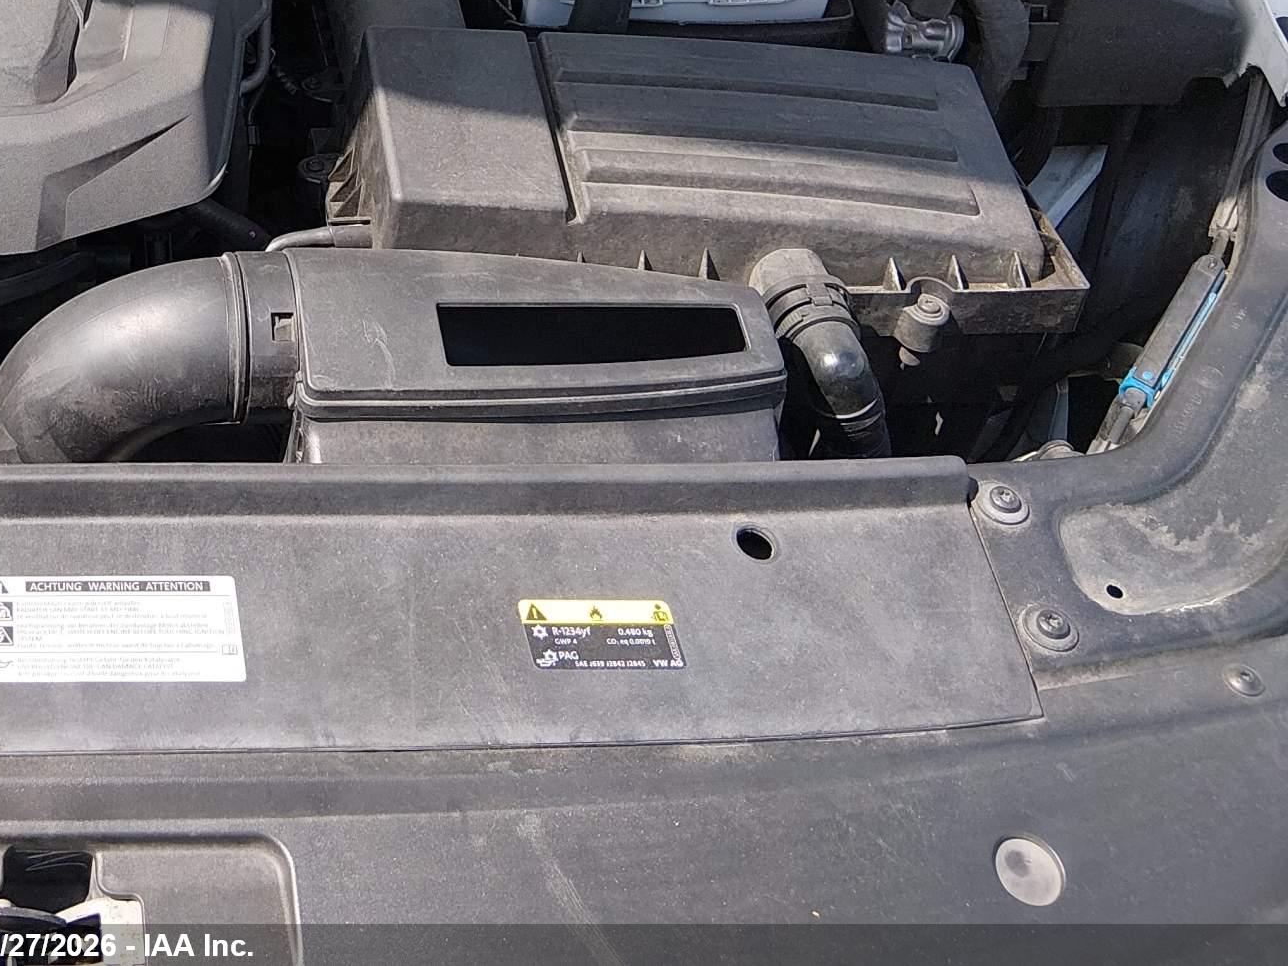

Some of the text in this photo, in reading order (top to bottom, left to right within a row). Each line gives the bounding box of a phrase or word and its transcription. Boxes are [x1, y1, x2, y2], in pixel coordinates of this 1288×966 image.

[30, 581, 204, 592] ACHTUNG WARNING ATTENTION
[552, 626, 591, 638] R-1234yf
[642, 627, 654, 638] kg
[558, 650, 579, 661] PAG
[652, 659, 669, 668] VW
[669, 659, 684, 668] AG
